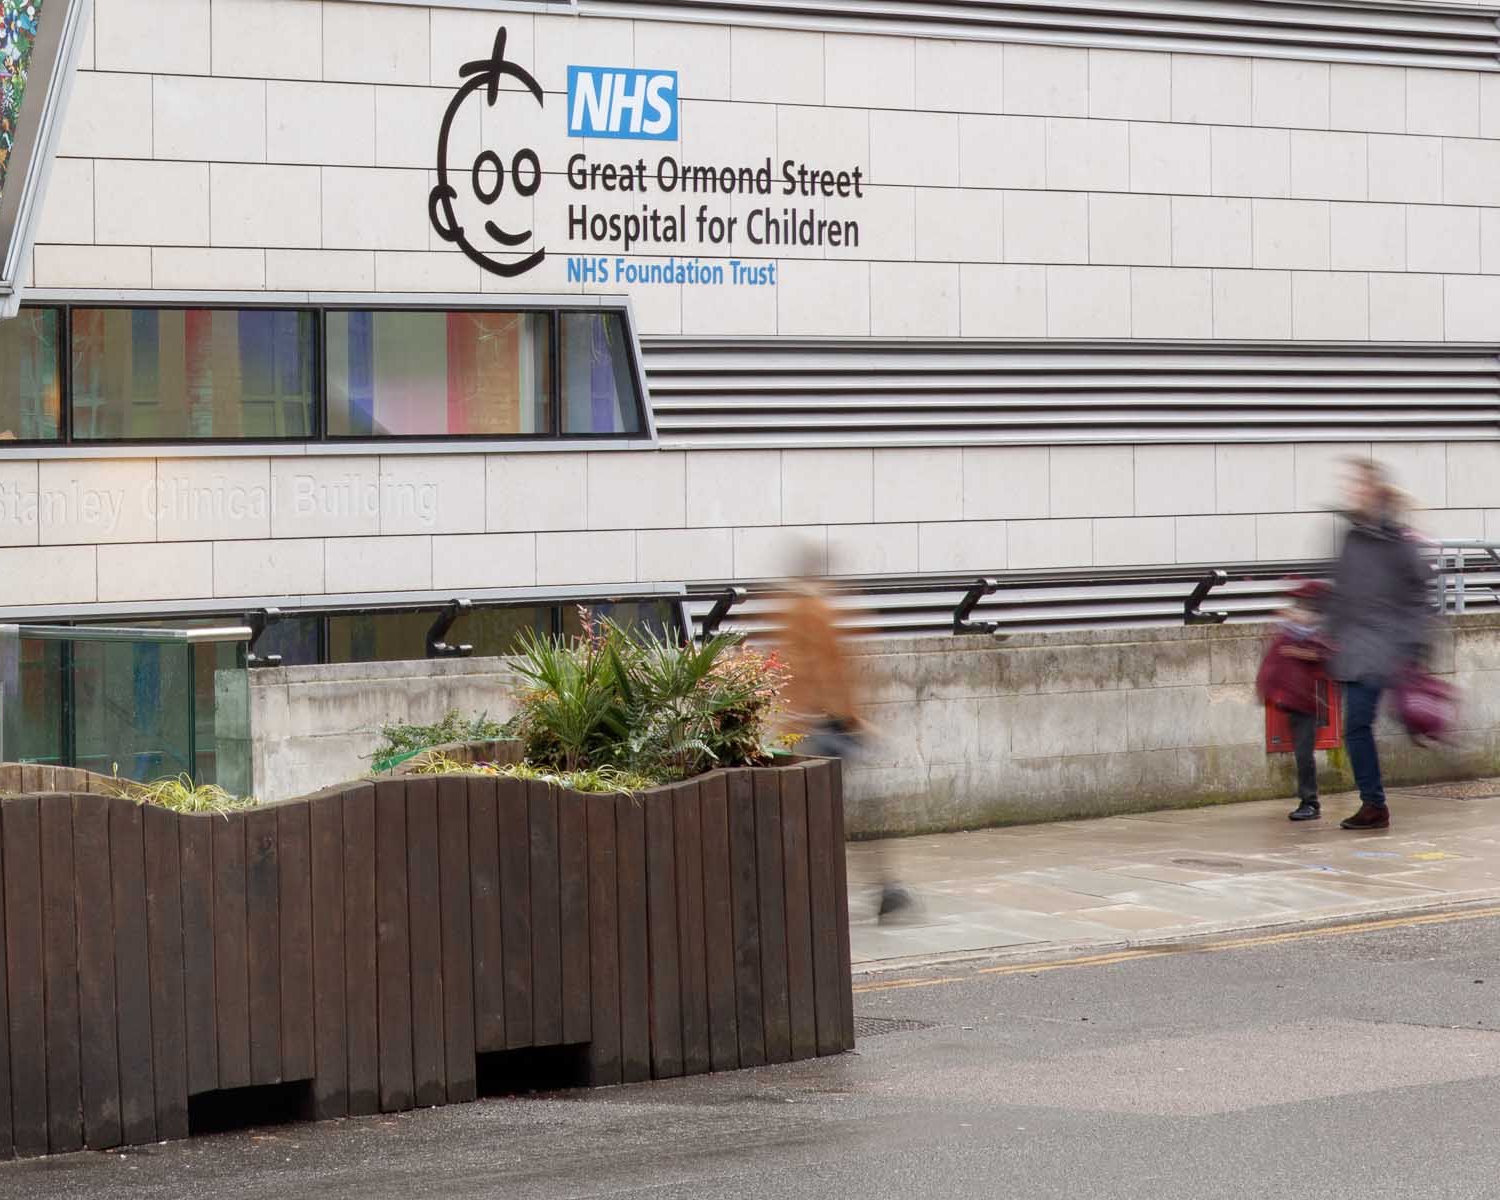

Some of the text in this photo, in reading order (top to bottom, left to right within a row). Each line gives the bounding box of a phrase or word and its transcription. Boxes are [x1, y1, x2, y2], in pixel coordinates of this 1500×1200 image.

[571, 71, 675, 135] NHS
[567, 153, 863, 198] Great Ormond Street
[568, 204, 859, 252] Hospital for Children
[567, 257, 776, 285] NHS Foundation Trust
[145, 474, 277, 523] Clinical
[295, 472, 440, 527] Building
